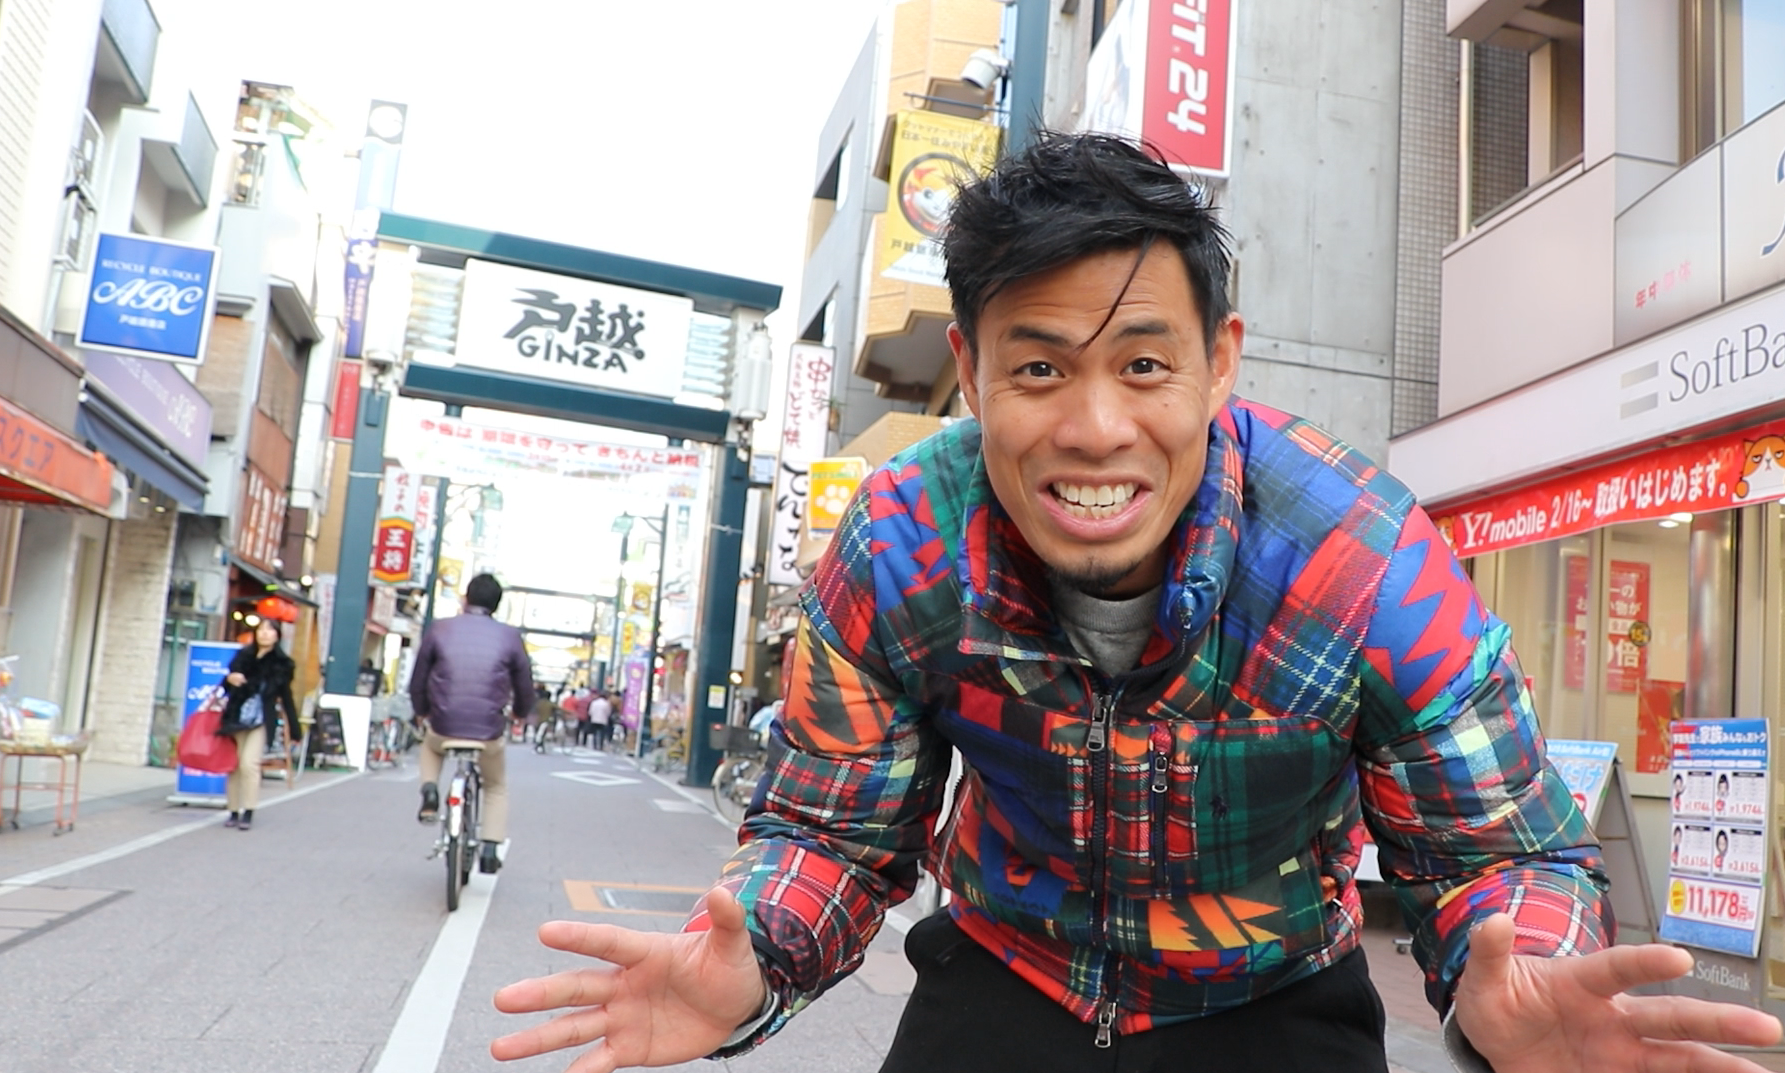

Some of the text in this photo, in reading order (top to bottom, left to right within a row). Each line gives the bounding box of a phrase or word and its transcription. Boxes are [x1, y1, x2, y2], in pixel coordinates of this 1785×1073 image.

[1167, 57, 1209, 135] 24
[93, 277, 205, 317] ABC
[503, 288, 646, 360] 戸越
[517, 330, 627, 374] GINZA
[1462, 508, 1547, 551] Y!mobile
[1696, 960, 1752, 992] SoftBank
